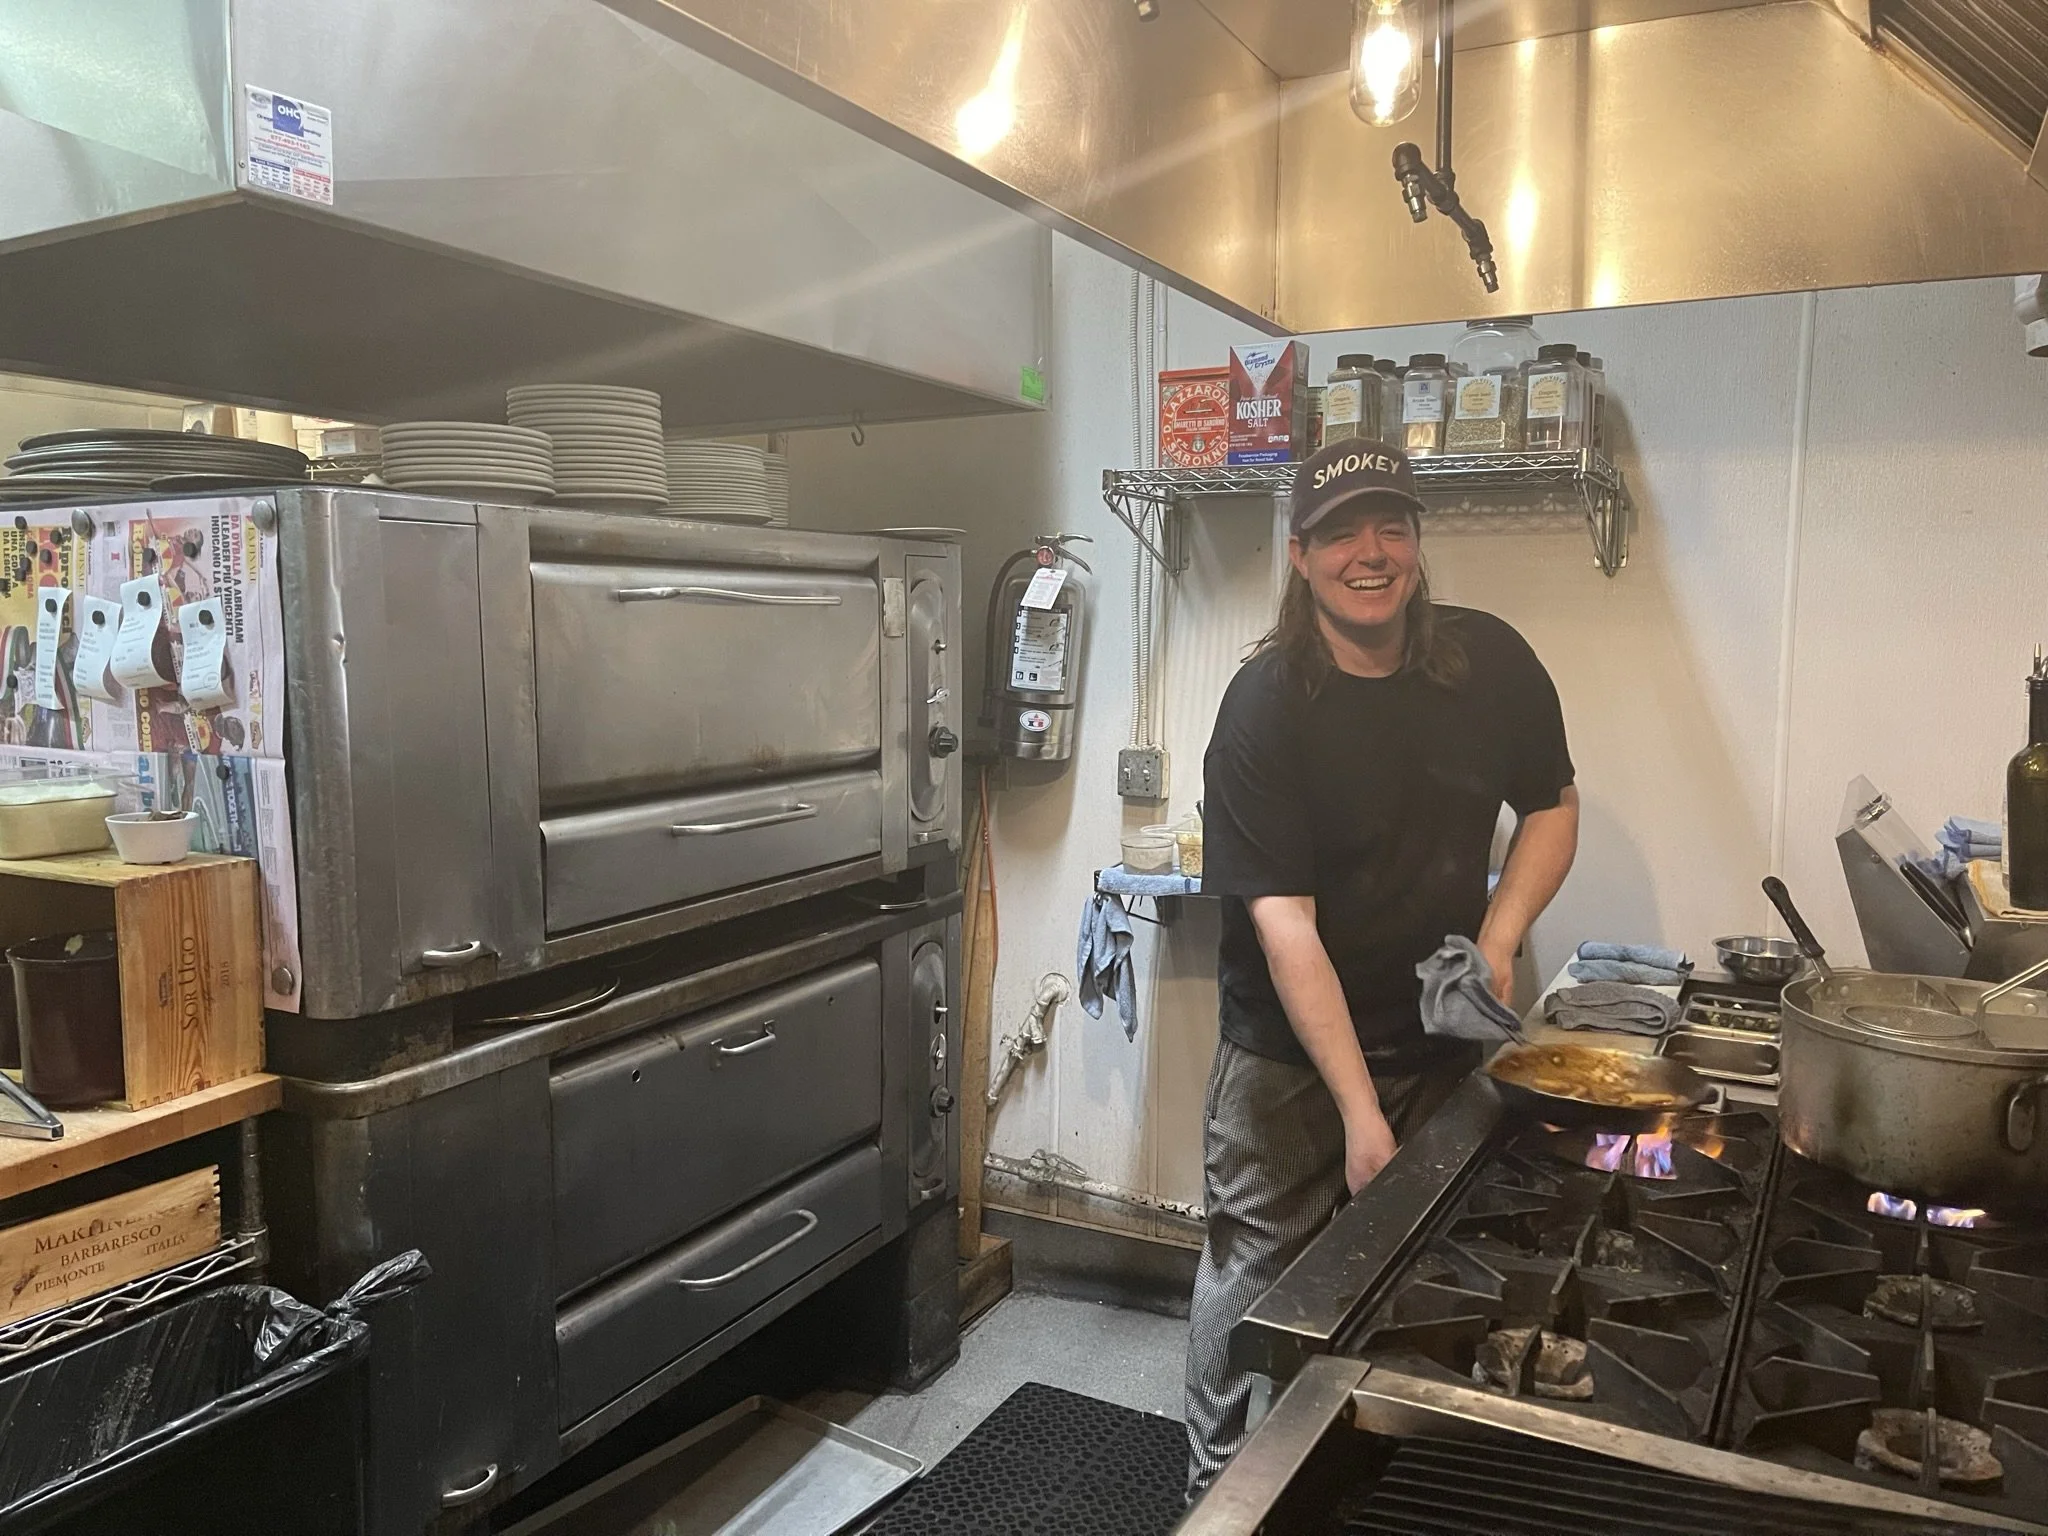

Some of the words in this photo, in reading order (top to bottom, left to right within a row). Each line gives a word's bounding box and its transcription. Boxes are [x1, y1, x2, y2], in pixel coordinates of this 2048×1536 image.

[278, 104, 301, 120] OHC
[1254, 358, 1275, 369] Crystal
[1236, 399, 1282, 420] KOSHER
[1247, 418, 1269, 428] SALT
[1167, 441, 1229, 466] SARONNO
[1313, 453, 1400, 489] SMOKEY
[3, 531, 10, 544] DA
[230, 515, 240, 530] DA
[211, 515, 221, 568] INDICANO
[221, 521, 231, 563] LEADER
[231, 532, 241, 576] DYBALA
[213, 571, 222, 584] LA
[233, 578, 242, 586] A
[223, 586, 234, 636] VINCENTI
[233, 588, 244, 643] ABRAHAM
[178, 937, 197, 985] UGO
[220, 961, 230, 986] 2018
[181, 990, 199, 1030] SOR
[61, 1224, 162, 1267] BARBARESCO
[34, 1261, 105, 1293] PIEMONTE
[145, 1234, 187, 1256] ITALIA
